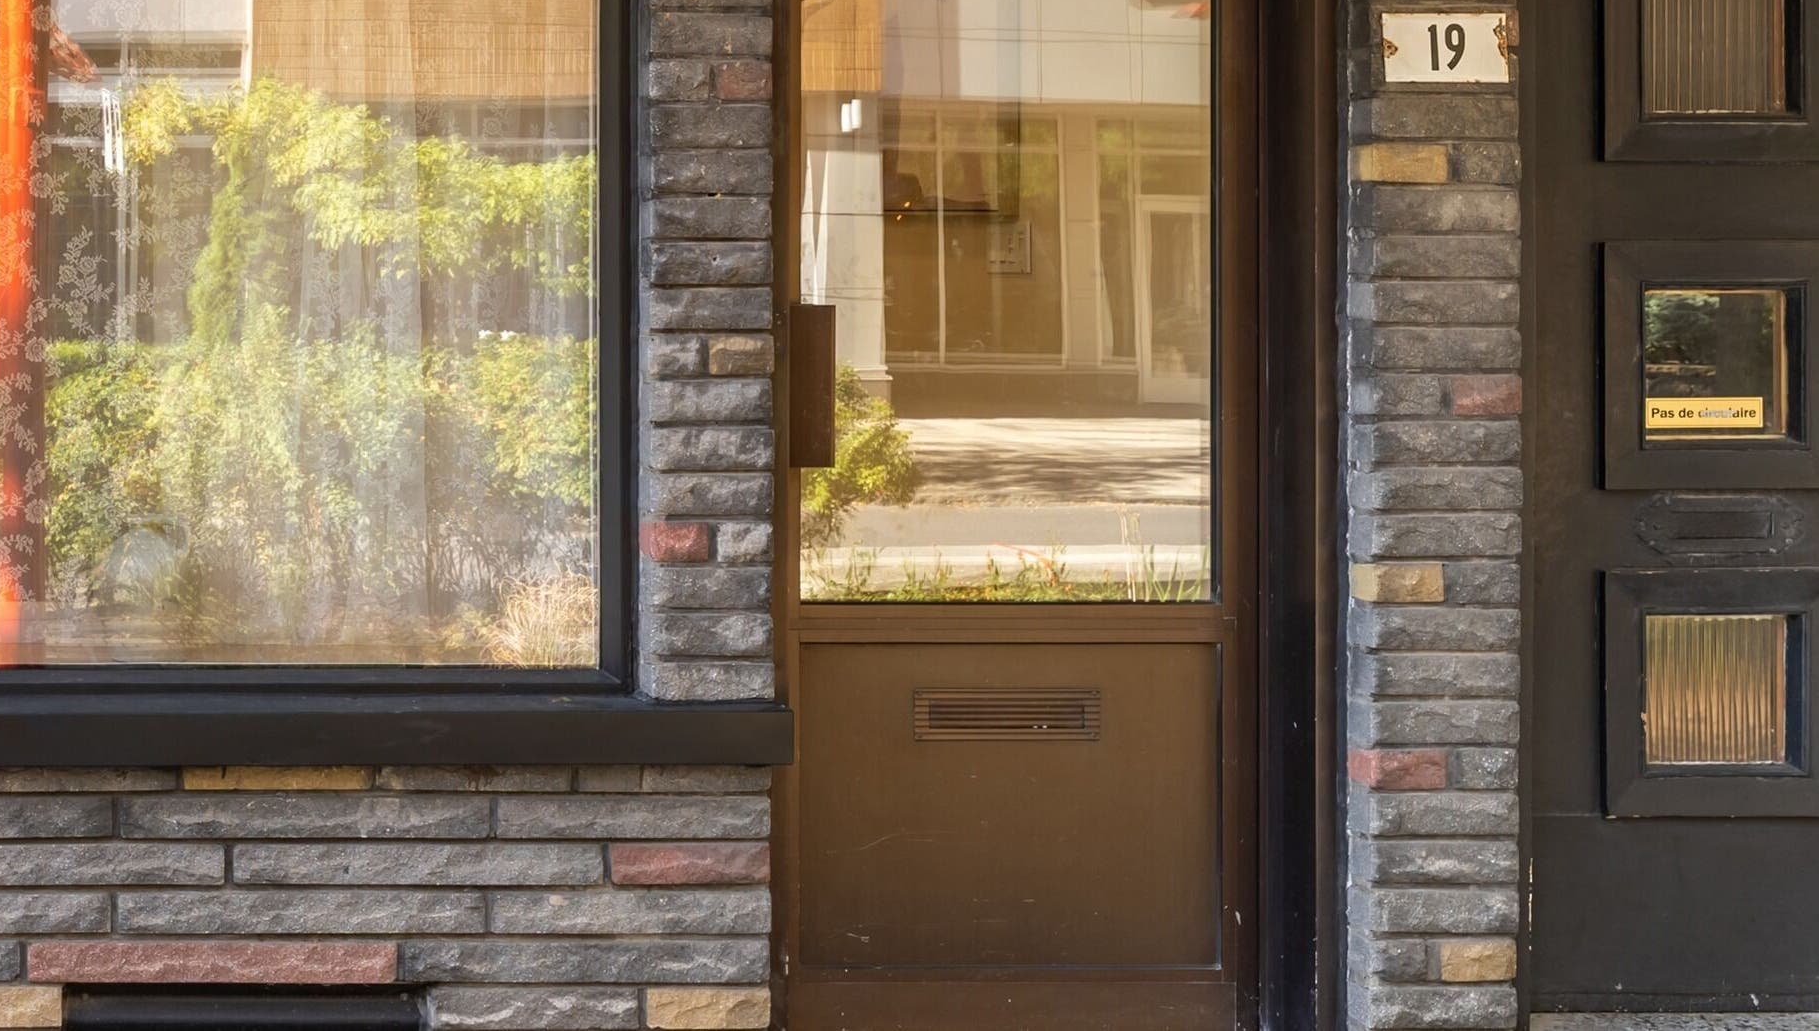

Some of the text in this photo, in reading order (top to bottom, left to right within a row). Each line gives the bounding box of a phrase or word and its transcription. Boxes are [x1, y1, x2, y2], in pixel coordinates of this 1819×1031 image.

[1428, 23, 1466, 71] 19
[1651, 407, 1675, 418] Pas
[1678, 407, 1694, 418] de
